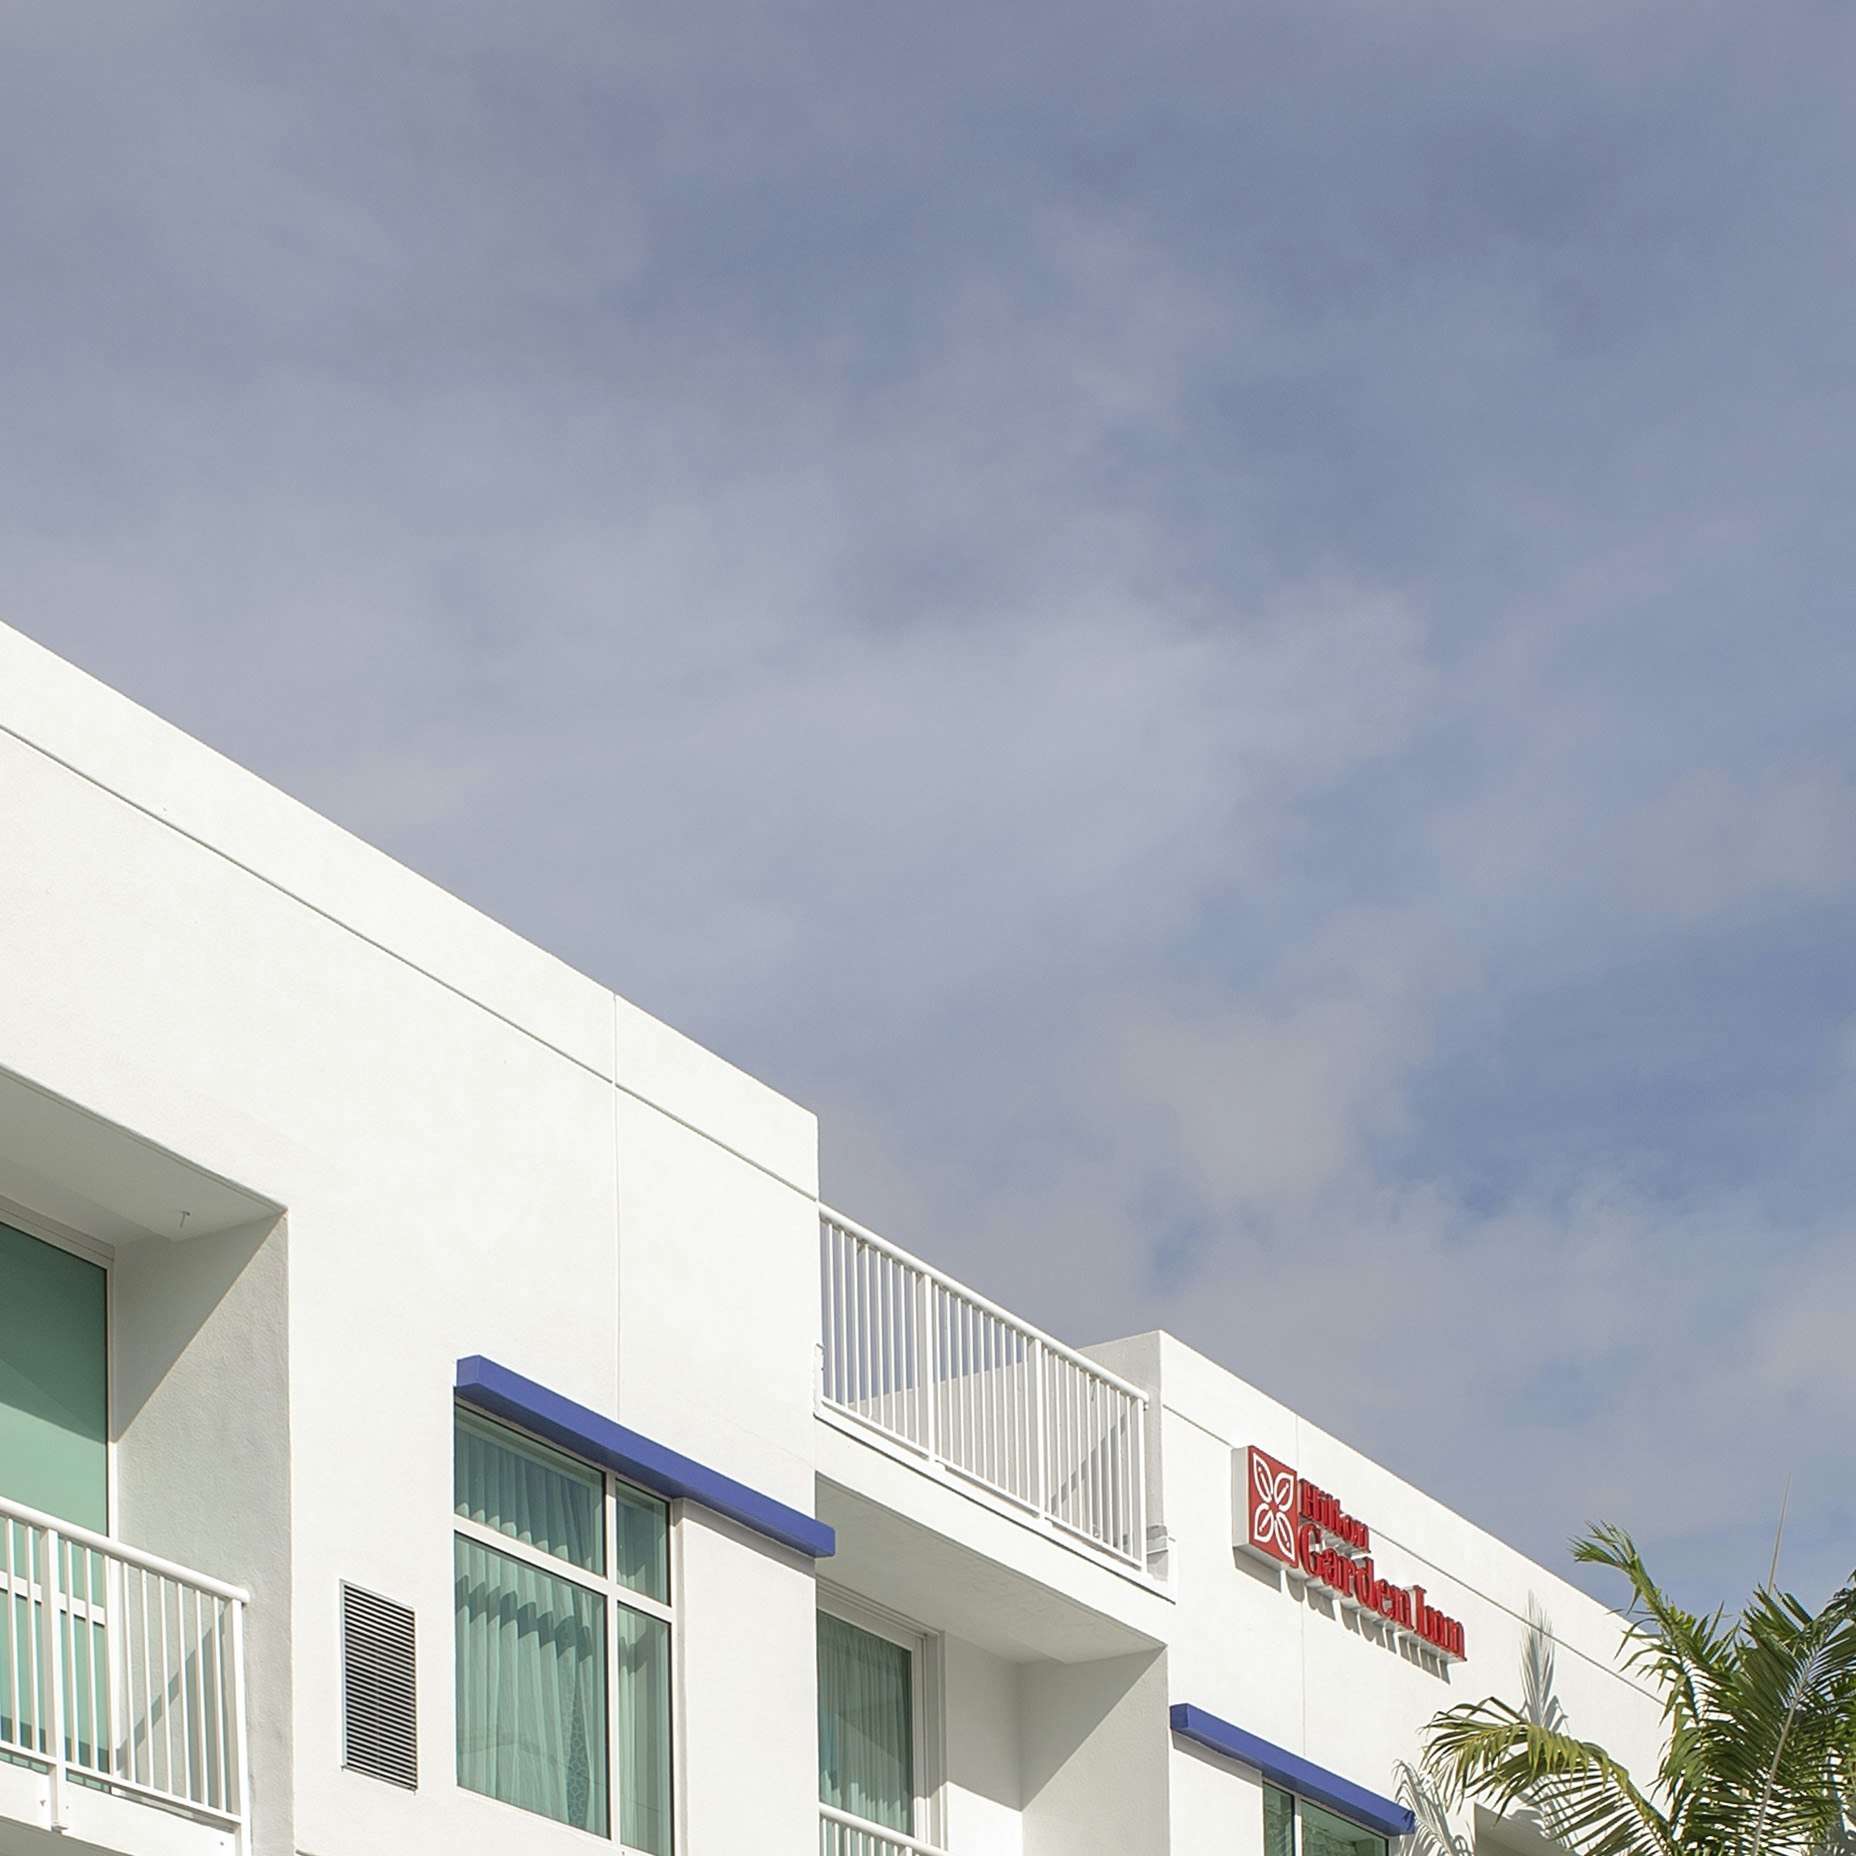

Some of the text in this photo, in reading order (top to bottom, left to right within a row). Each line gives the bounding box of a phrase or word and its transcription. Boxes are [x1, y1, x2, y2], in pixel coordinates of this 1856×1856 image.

[1299, 1478, 1371, 1553] Hilton
[1300, 1522, 1467, 1661] Garden Inn
